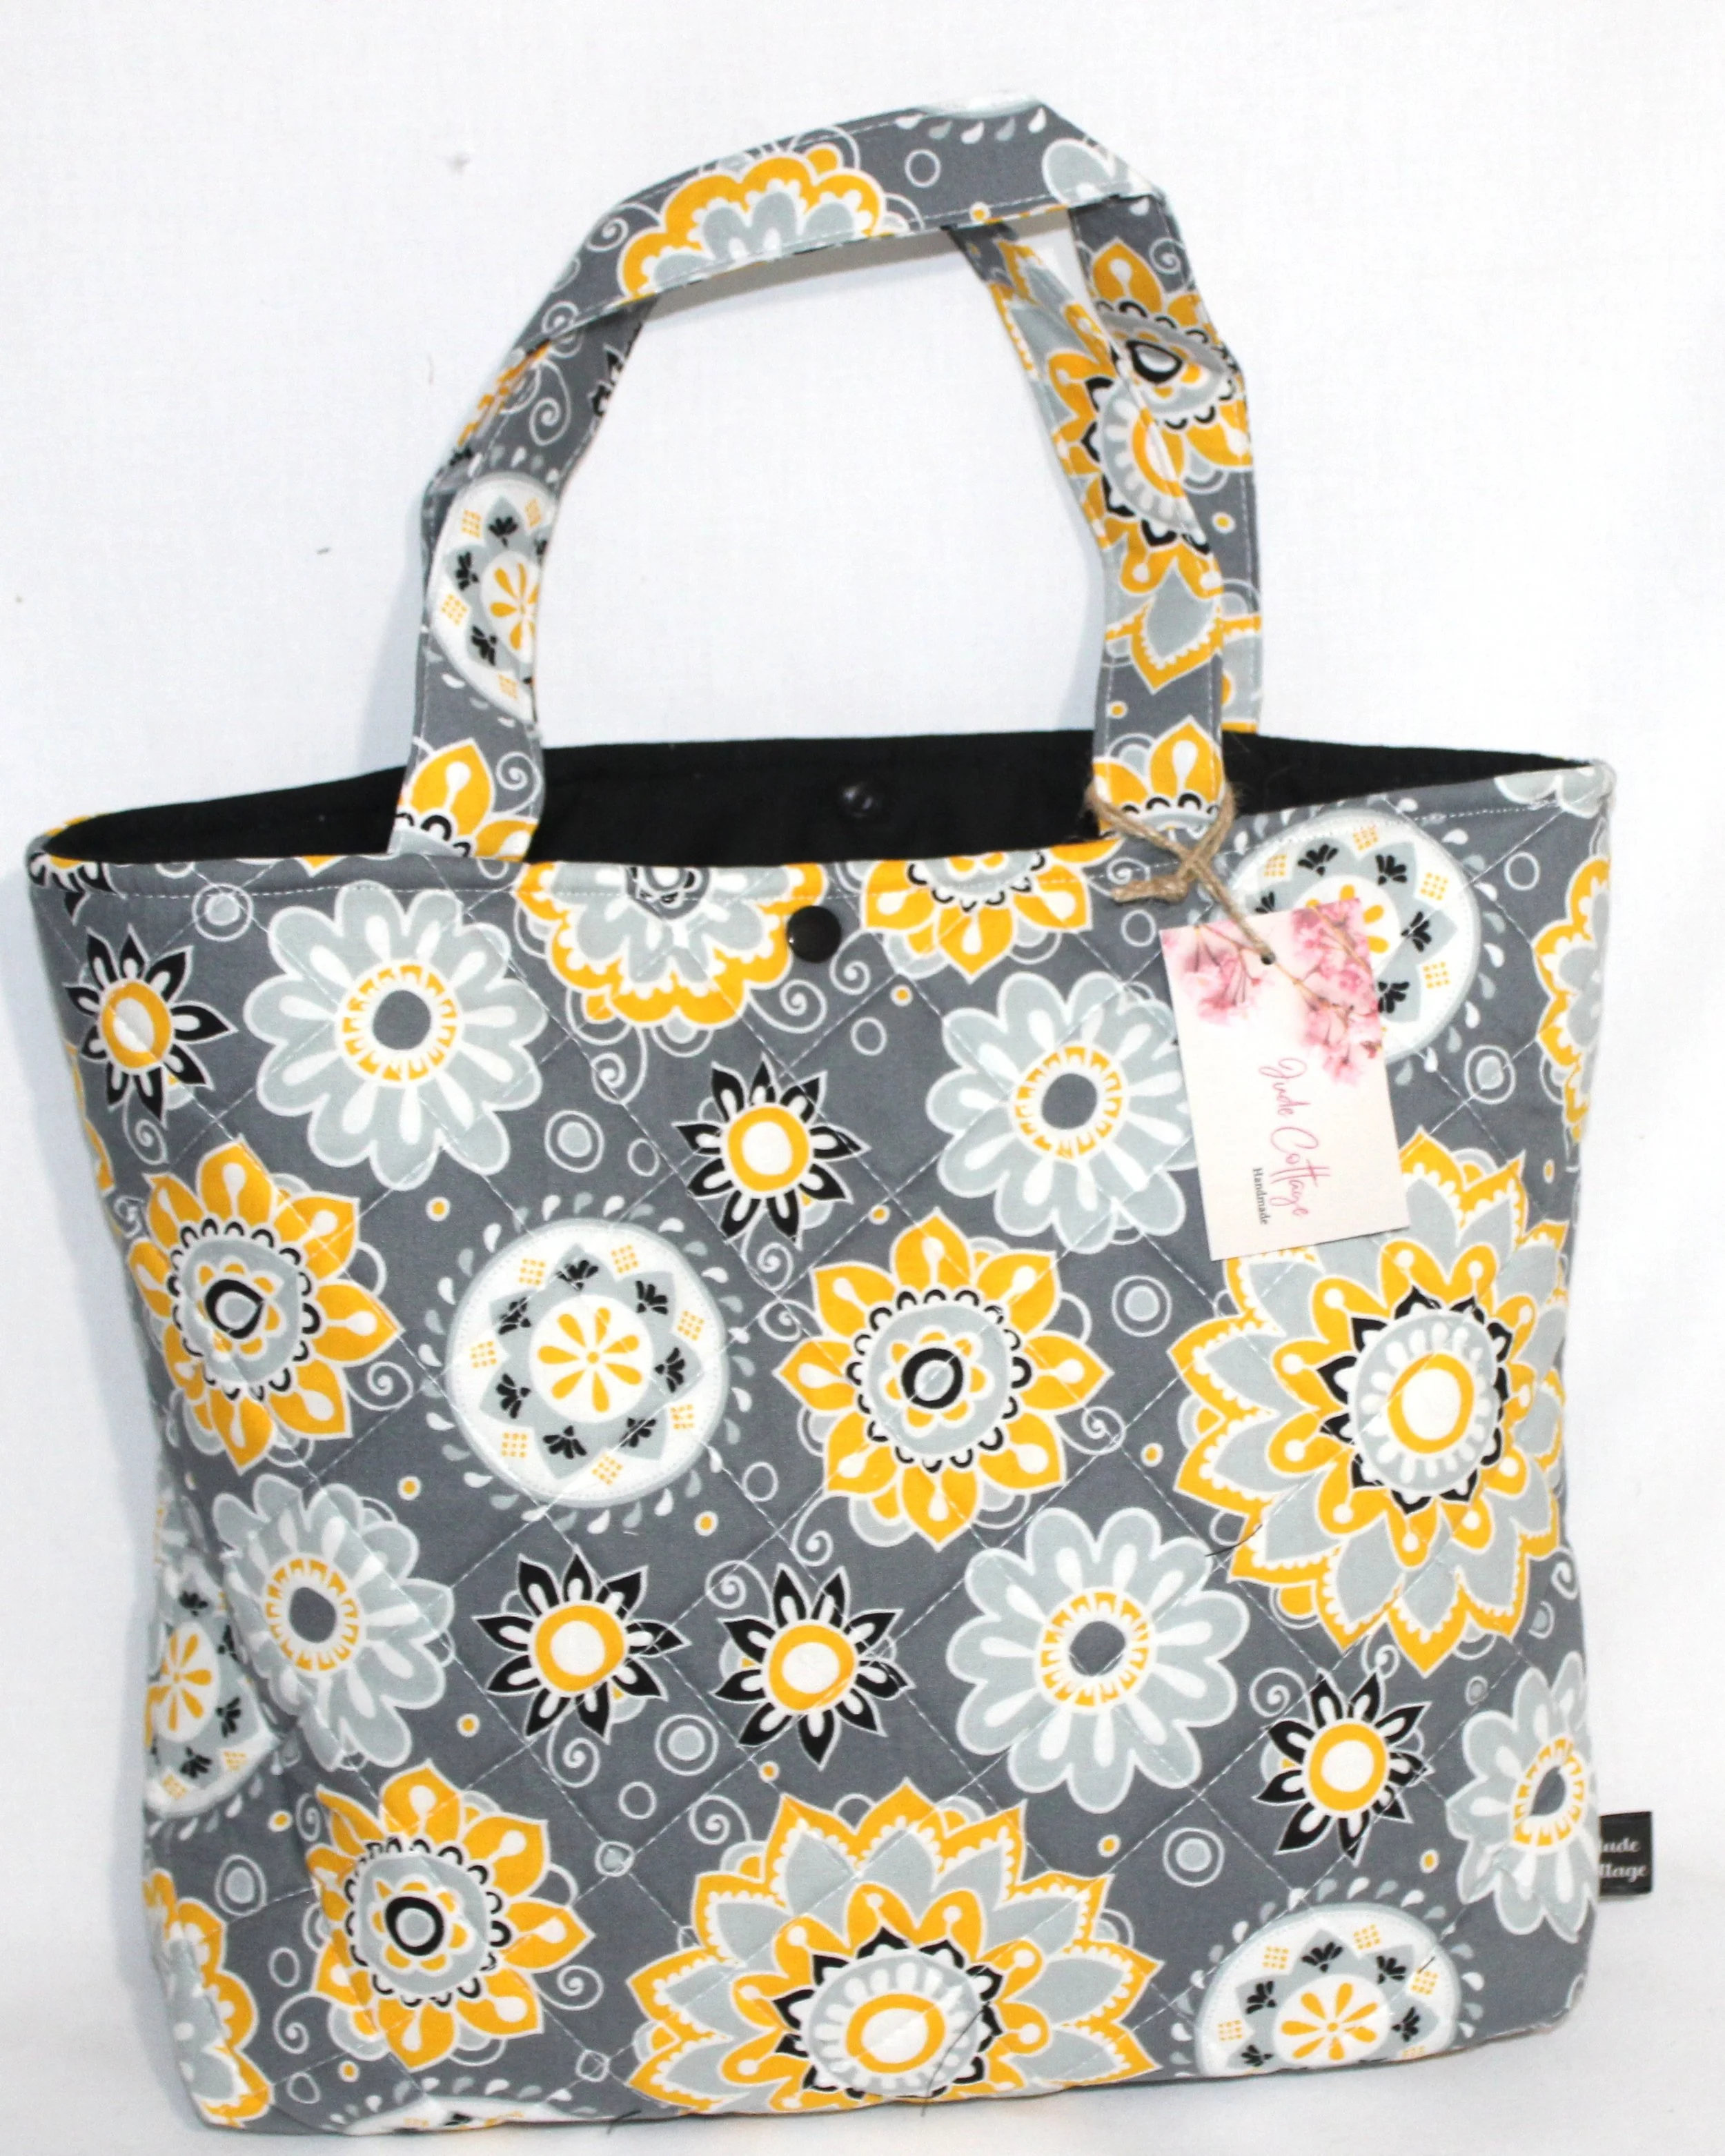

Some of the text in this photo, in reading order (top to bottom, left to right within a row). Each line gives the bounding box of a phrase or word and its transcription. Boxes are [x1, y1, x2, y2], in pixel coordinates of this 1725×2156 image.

[1259, 1058, 1331, 1216] Jude Cottage
[1253, 1167, 1270, 1225] Handmade
[1601, 1837, 1641, 1853] ude
[1599, 1862, 1647, 1883] ttage
